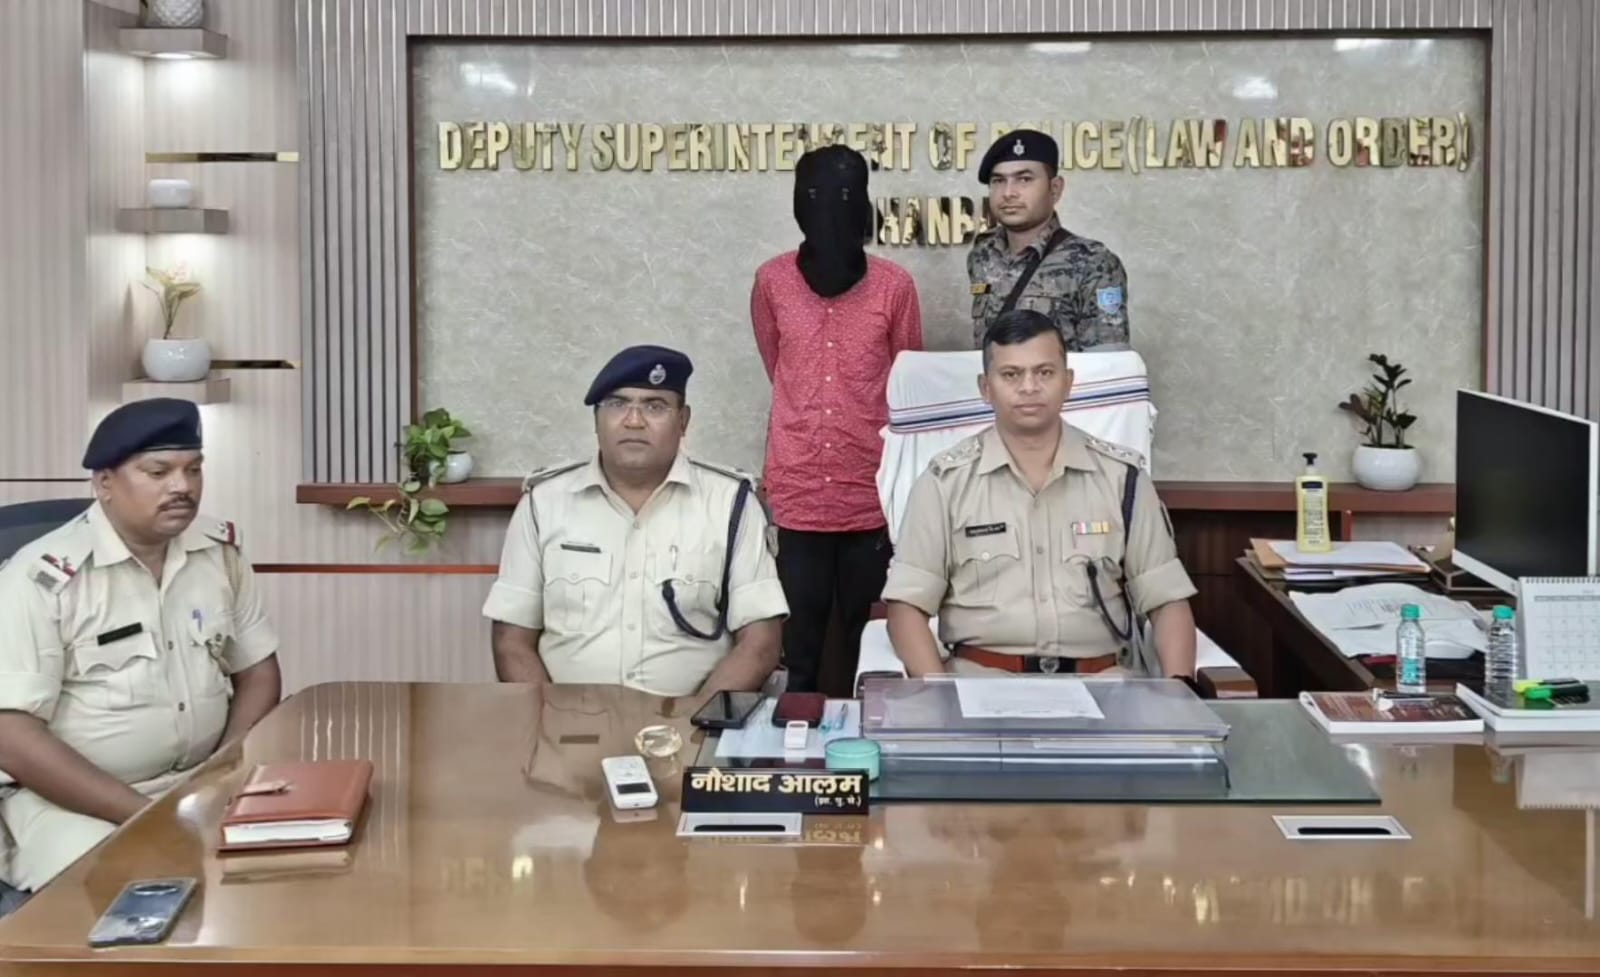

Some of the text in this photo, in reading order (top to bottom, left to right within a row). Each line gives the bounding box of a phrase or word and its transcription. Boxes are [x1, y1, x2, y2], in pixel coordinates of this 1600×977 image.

[438, 121, 585, 170] DEPUTY
[929, 121, 977, 170] OF
[1234, 117, 1315, 168] AND
[1328, 112, 1472, 172] ORDER)
[778, 774, 862, 794] आलम
